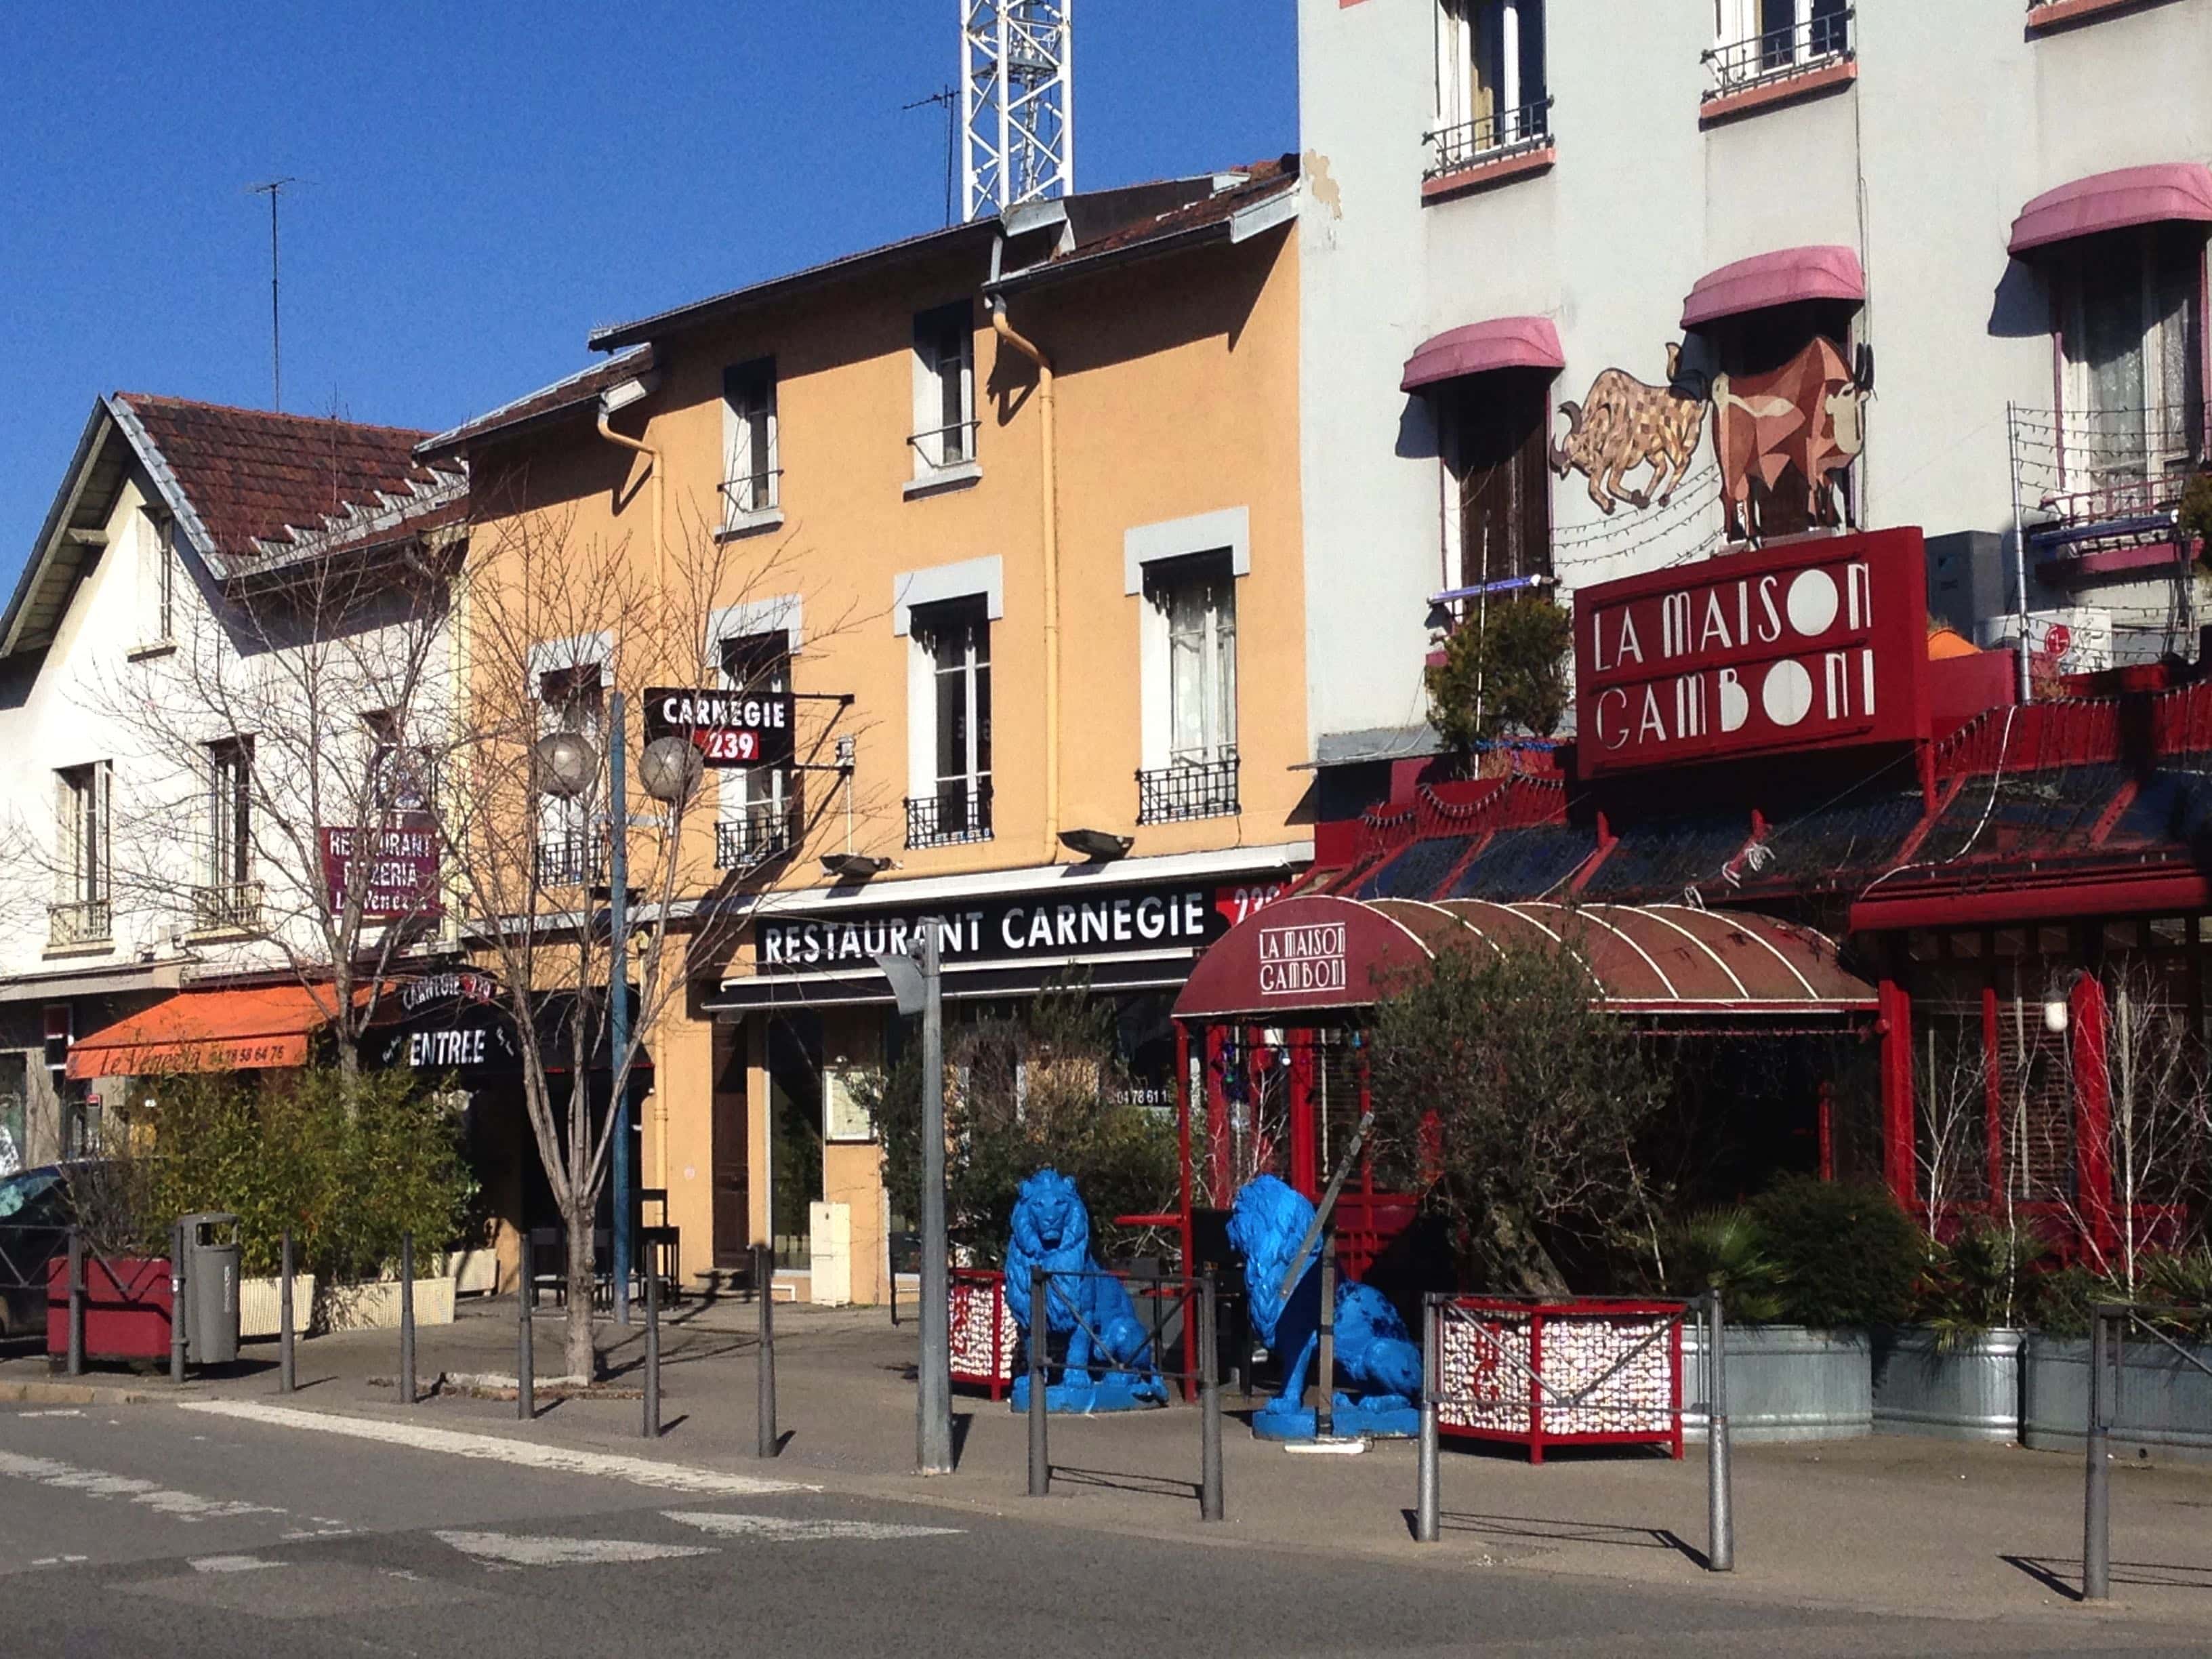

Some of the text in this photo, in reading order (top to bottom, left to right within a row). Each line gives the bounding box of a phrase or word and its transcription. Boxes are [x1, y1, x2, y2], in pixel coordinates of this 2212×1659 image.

[1594, 563, 1872, 672] LA MAISON
[663, 699, 785, 728] CARNEGIE
[1597, 649, 1875, 750] GAMBONI
[709, 733, 754, 759] 239
[1002, 893, 1204, 949] CARNEGIE
[1259, 927, 1346, 960] LA MAISON
[1260, 959, 1347, 991] GAMBONI
[99, 1050, 121, 1076] Le
[254, 1046, 268, 1062] 64
[409, 1029, 487, 1066] ENTREE
[1132, 1089, 1145, 1105] 78
[1147, 1089, 1159, 1104] 61
